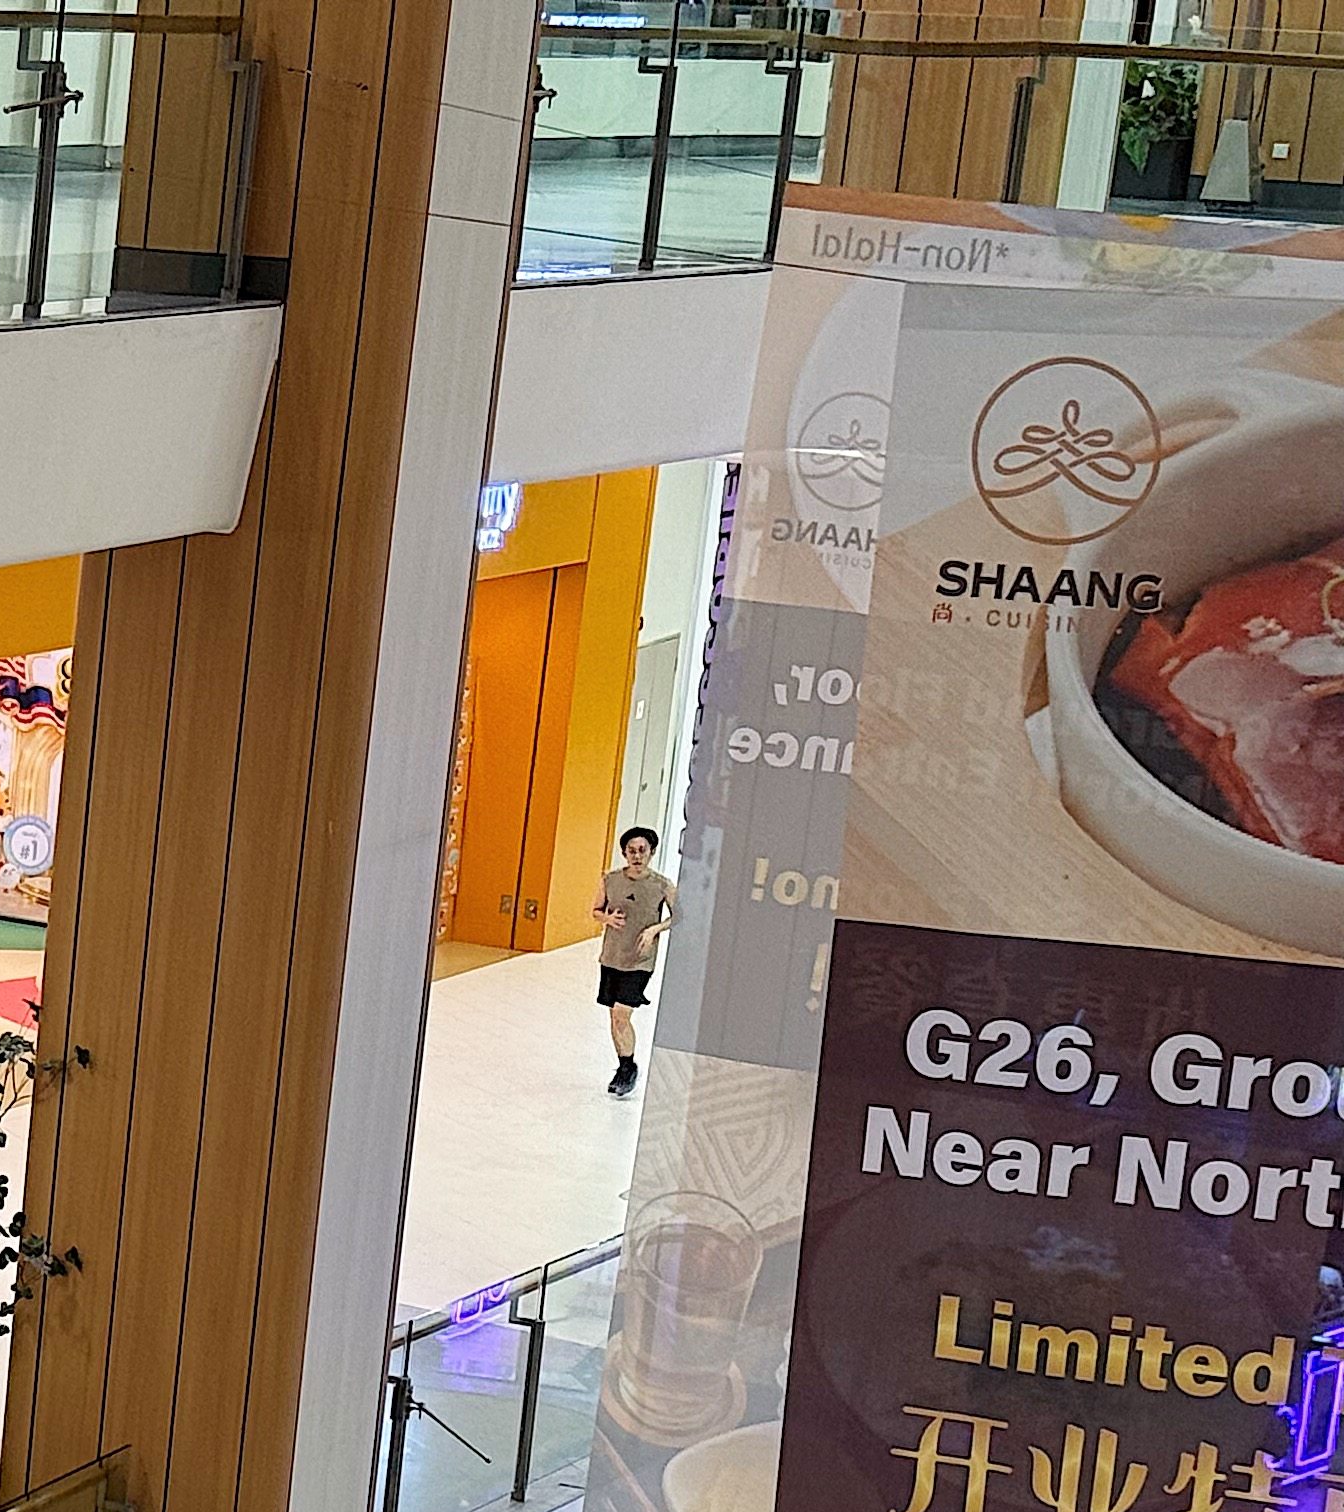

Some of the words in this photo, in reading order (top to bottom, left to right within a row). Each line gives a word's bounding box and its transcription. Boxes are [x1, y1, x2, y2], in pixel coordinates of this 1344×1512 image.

[936, 560, 1163, 612] SHAANG
[905, 1009, 1119, 1107] G26,
[1150, 1033, 1344, 1120] Gro
[861, 1105, 1090, 1199] Near
[1113, 1135, 1344, 1229] Nort
[933, 1294, 1296, 1407] Limited
